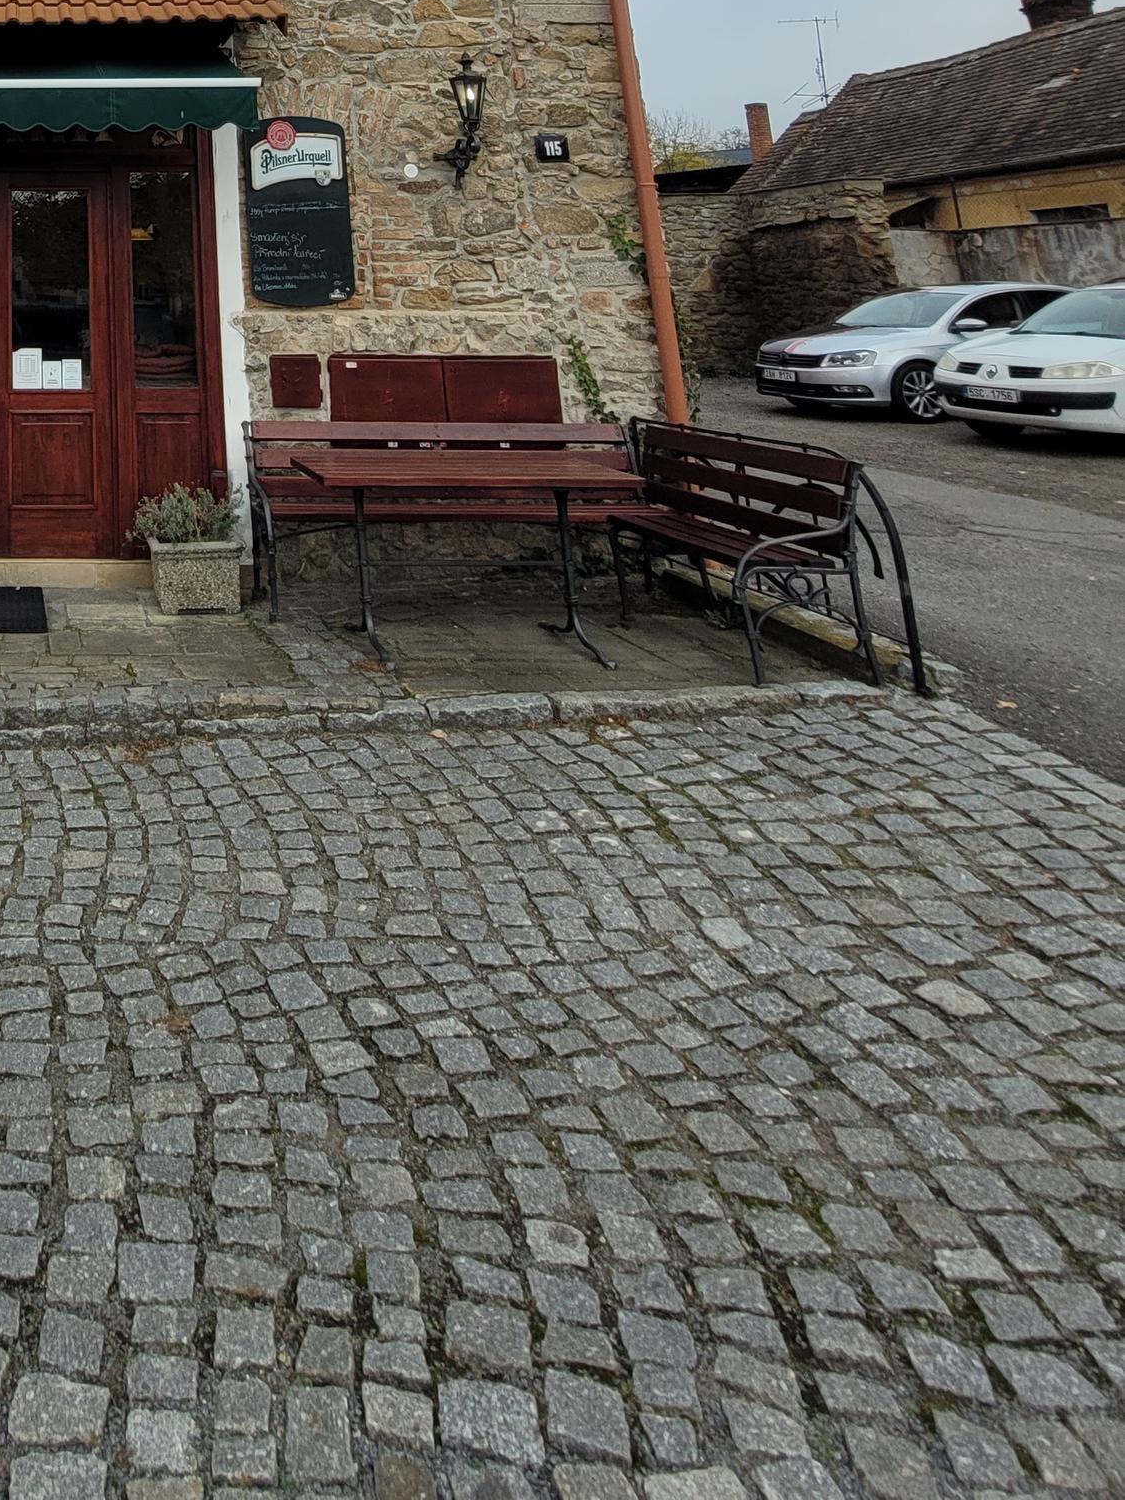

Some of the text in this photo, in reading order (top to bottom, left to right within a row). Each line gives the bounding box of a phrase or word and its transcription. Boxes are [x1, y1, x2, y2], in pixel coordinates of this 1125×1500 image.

[544, 141, 562, 156] 115
[261, 148, 331, 174] Pilsner Urquell
[991, 390, 1013, 401] 1756
